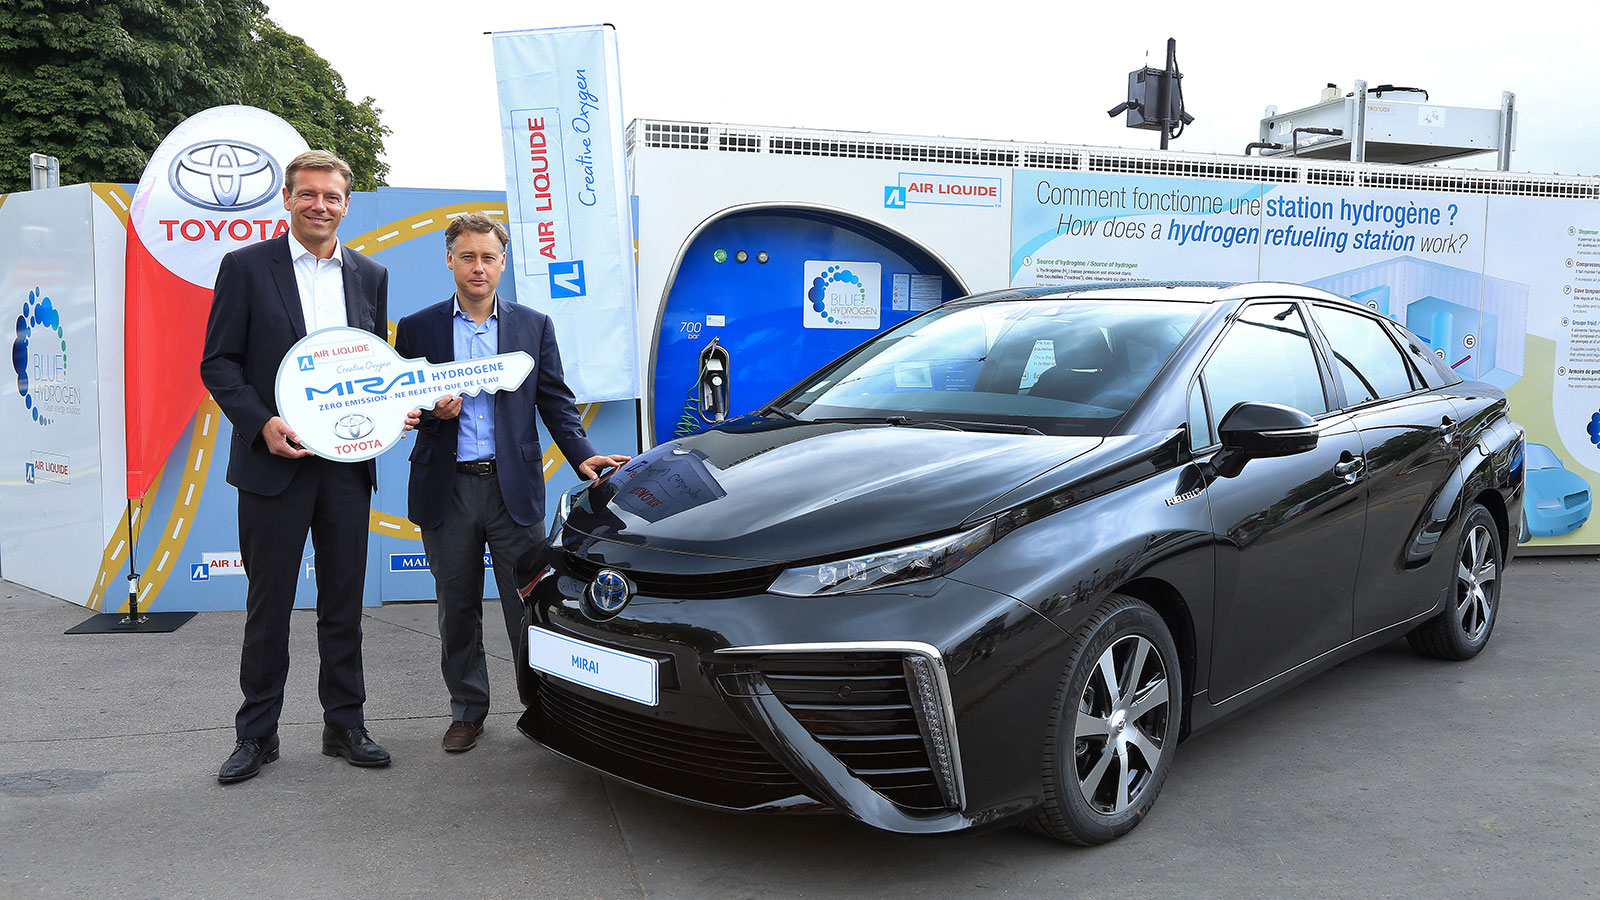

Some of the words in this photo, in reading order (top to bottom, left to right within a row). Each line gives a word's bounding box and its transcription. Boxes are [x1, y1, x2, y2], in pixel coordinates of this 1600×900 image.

[571, 69, 600, 134] Oxygen
[528, 116, 553, 212] LIQUIDE
[575, 136, 597, 207] Creative
[908, 182, 934, 193] AIR
[938, 184, 997, 196] LIQUIDE
[1036, 180, 1126, 210] Comment
[1132, 186, 1224, 214] fonctionne
[1229, 198, 1261, 216] une
[1266, 195, 1334, 220] station
[1340, 198, 1441, 229] hydrogène
[1448, 204, 1458, 226] ?
[159, 219, 290, 241] TOYOTA
[538, 220, 557, 260] AIR
[1057, 214, 1099, 237] How
[1102, 216, 1147, 240] does
[1150, 224, 1162, 240] a
[1168, 218, 1259, 248] hydrogen
[1264, 220, 1348, 253] refueling
[1353, 228, 1416, 252] station
[1420, 234, 1469, 254] work?
[830, 293, 861, 306] BLUE
[830, 307, 877, 315] HYDROGEN
[679, 322, 702, 334] 700
[313, 349, 329, 359] AIR
[332, 344, 370, 356] LIQUIDE
[33, 354, 63, 383] BLUE
[336, 363, 364, 375] Creative
[365, 360, 392, 373] Oxygen
[305, 370, 425, 401] MIRAI
[431, 362, 505, 382] HYDROGENE
[34, 384, 81, 405] HYDROGEN
[319, 401, 342, 411] ZERO
[345, 394, 388, 408] EMISSION
[408, 385, 443, 396] REJETTE
[445, 382, 462, 391] QUE
[477, 376, 499, 386] L'EAU
[335, 440, 382, 455] TOYOTA
[34, 460, 44, 471] AIR
[45, 462, 68, 476] LIQUIDE
[210, 559, 229, 568] AIR
[571, 654, 599, 674] MIRAI
